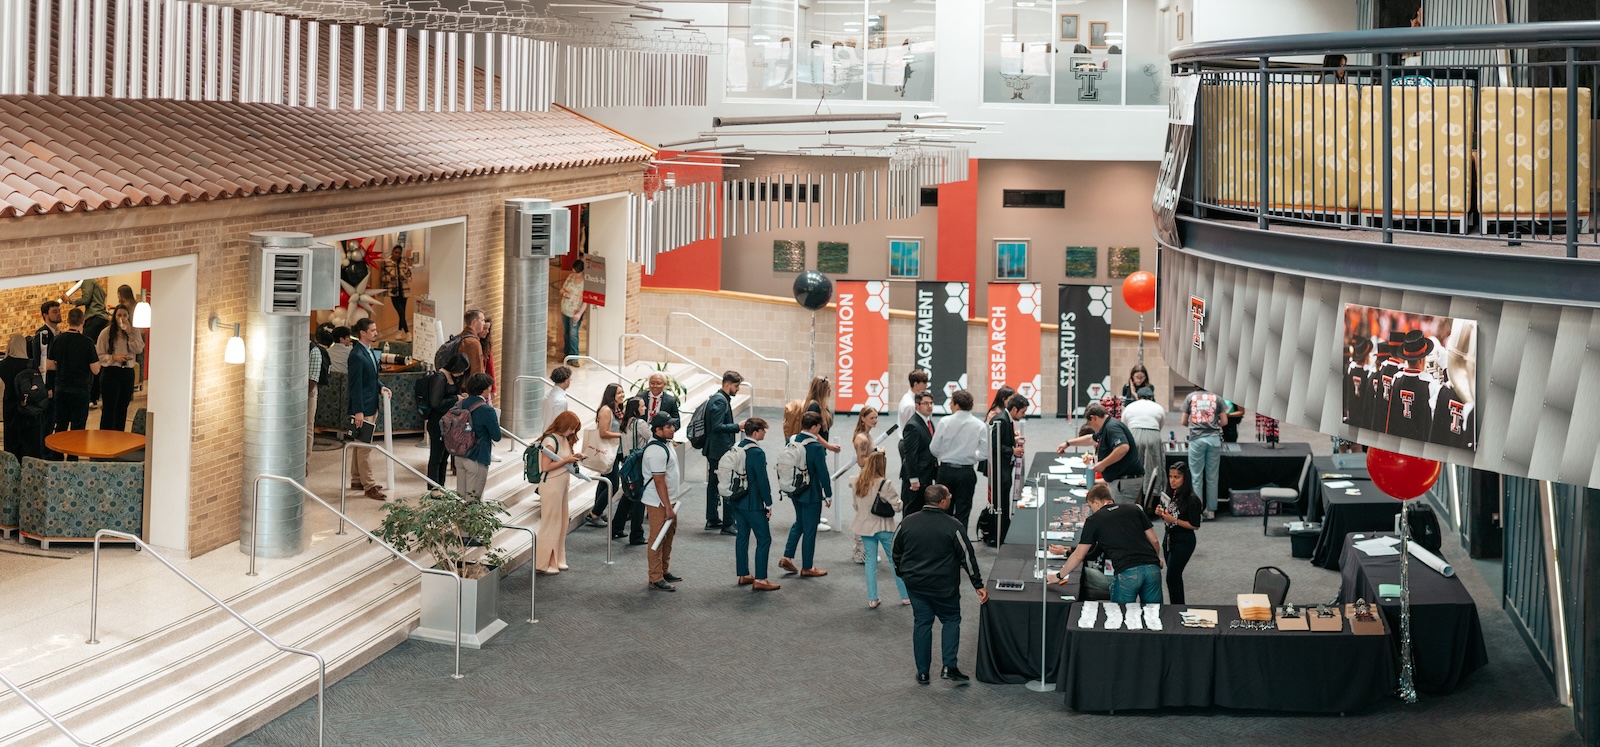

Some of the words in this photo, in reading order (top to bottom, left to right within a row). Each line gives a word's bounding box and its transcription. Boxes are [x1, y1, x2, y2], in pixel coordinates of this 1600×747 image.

[584, 274, 606, 284] Check-In
[838, 293, 854, 398] INNOVATION
[991, 306, 1007, 390] RESEARCH
[1060, 312, 1077, 387] STARTUPS
